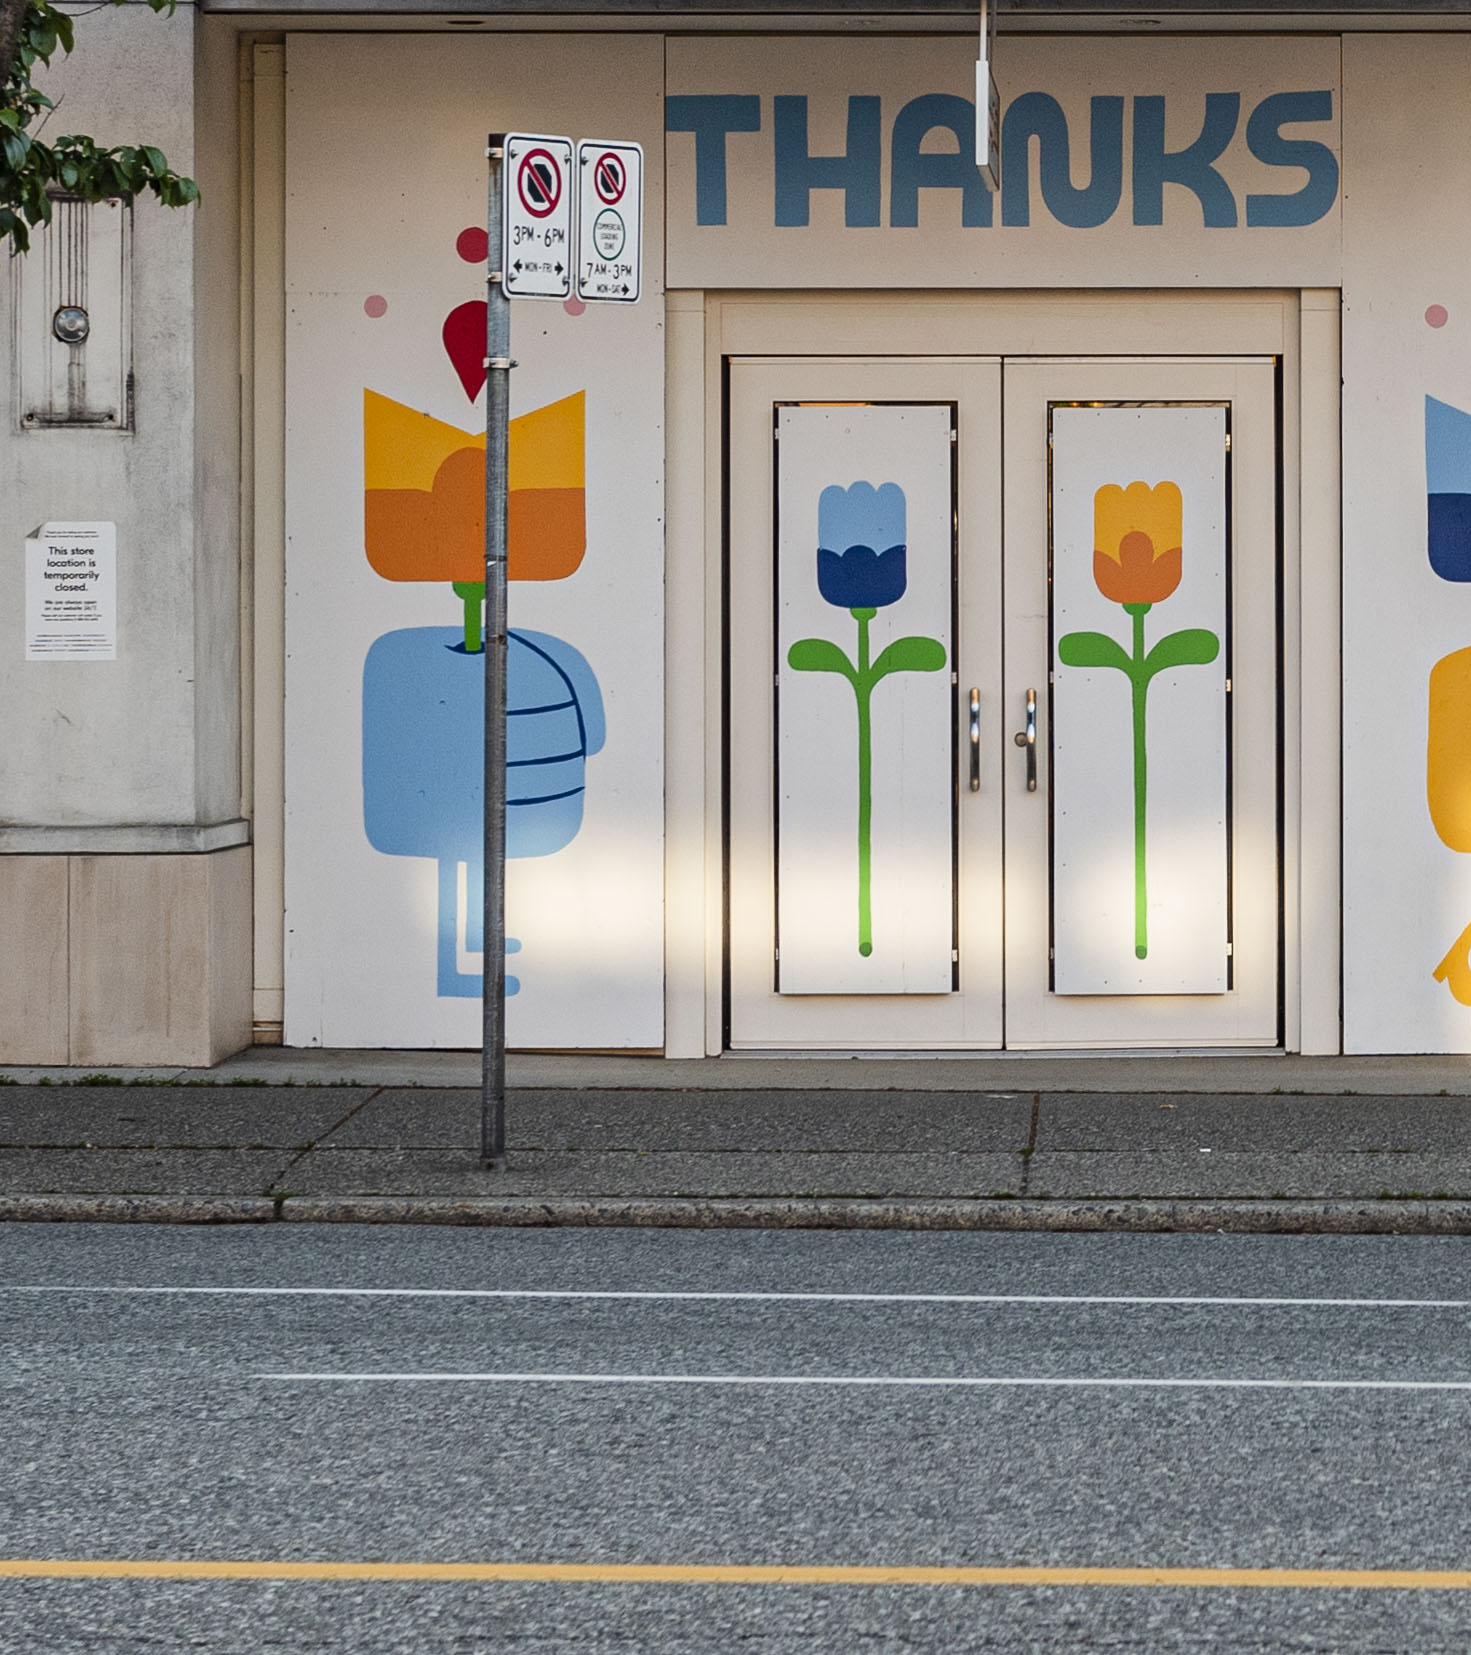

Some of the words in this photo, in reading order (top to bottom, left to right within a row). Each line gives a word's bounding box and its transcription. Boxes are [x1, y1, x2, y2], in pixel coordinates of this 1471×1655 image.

[665, 90, 1340, 228] THANKS
[513, 225, 534, 245] 3PM
[544, 228, 565, 248] 6PM
[48, 546, 68, 555] This
[70, 546, 95, 555] store
[47, 558, 86, 567] location
[88, 558, 96, 567] is
[44, 570, 100, 582] temporarily
[54, 583, 89, 592] closed.
